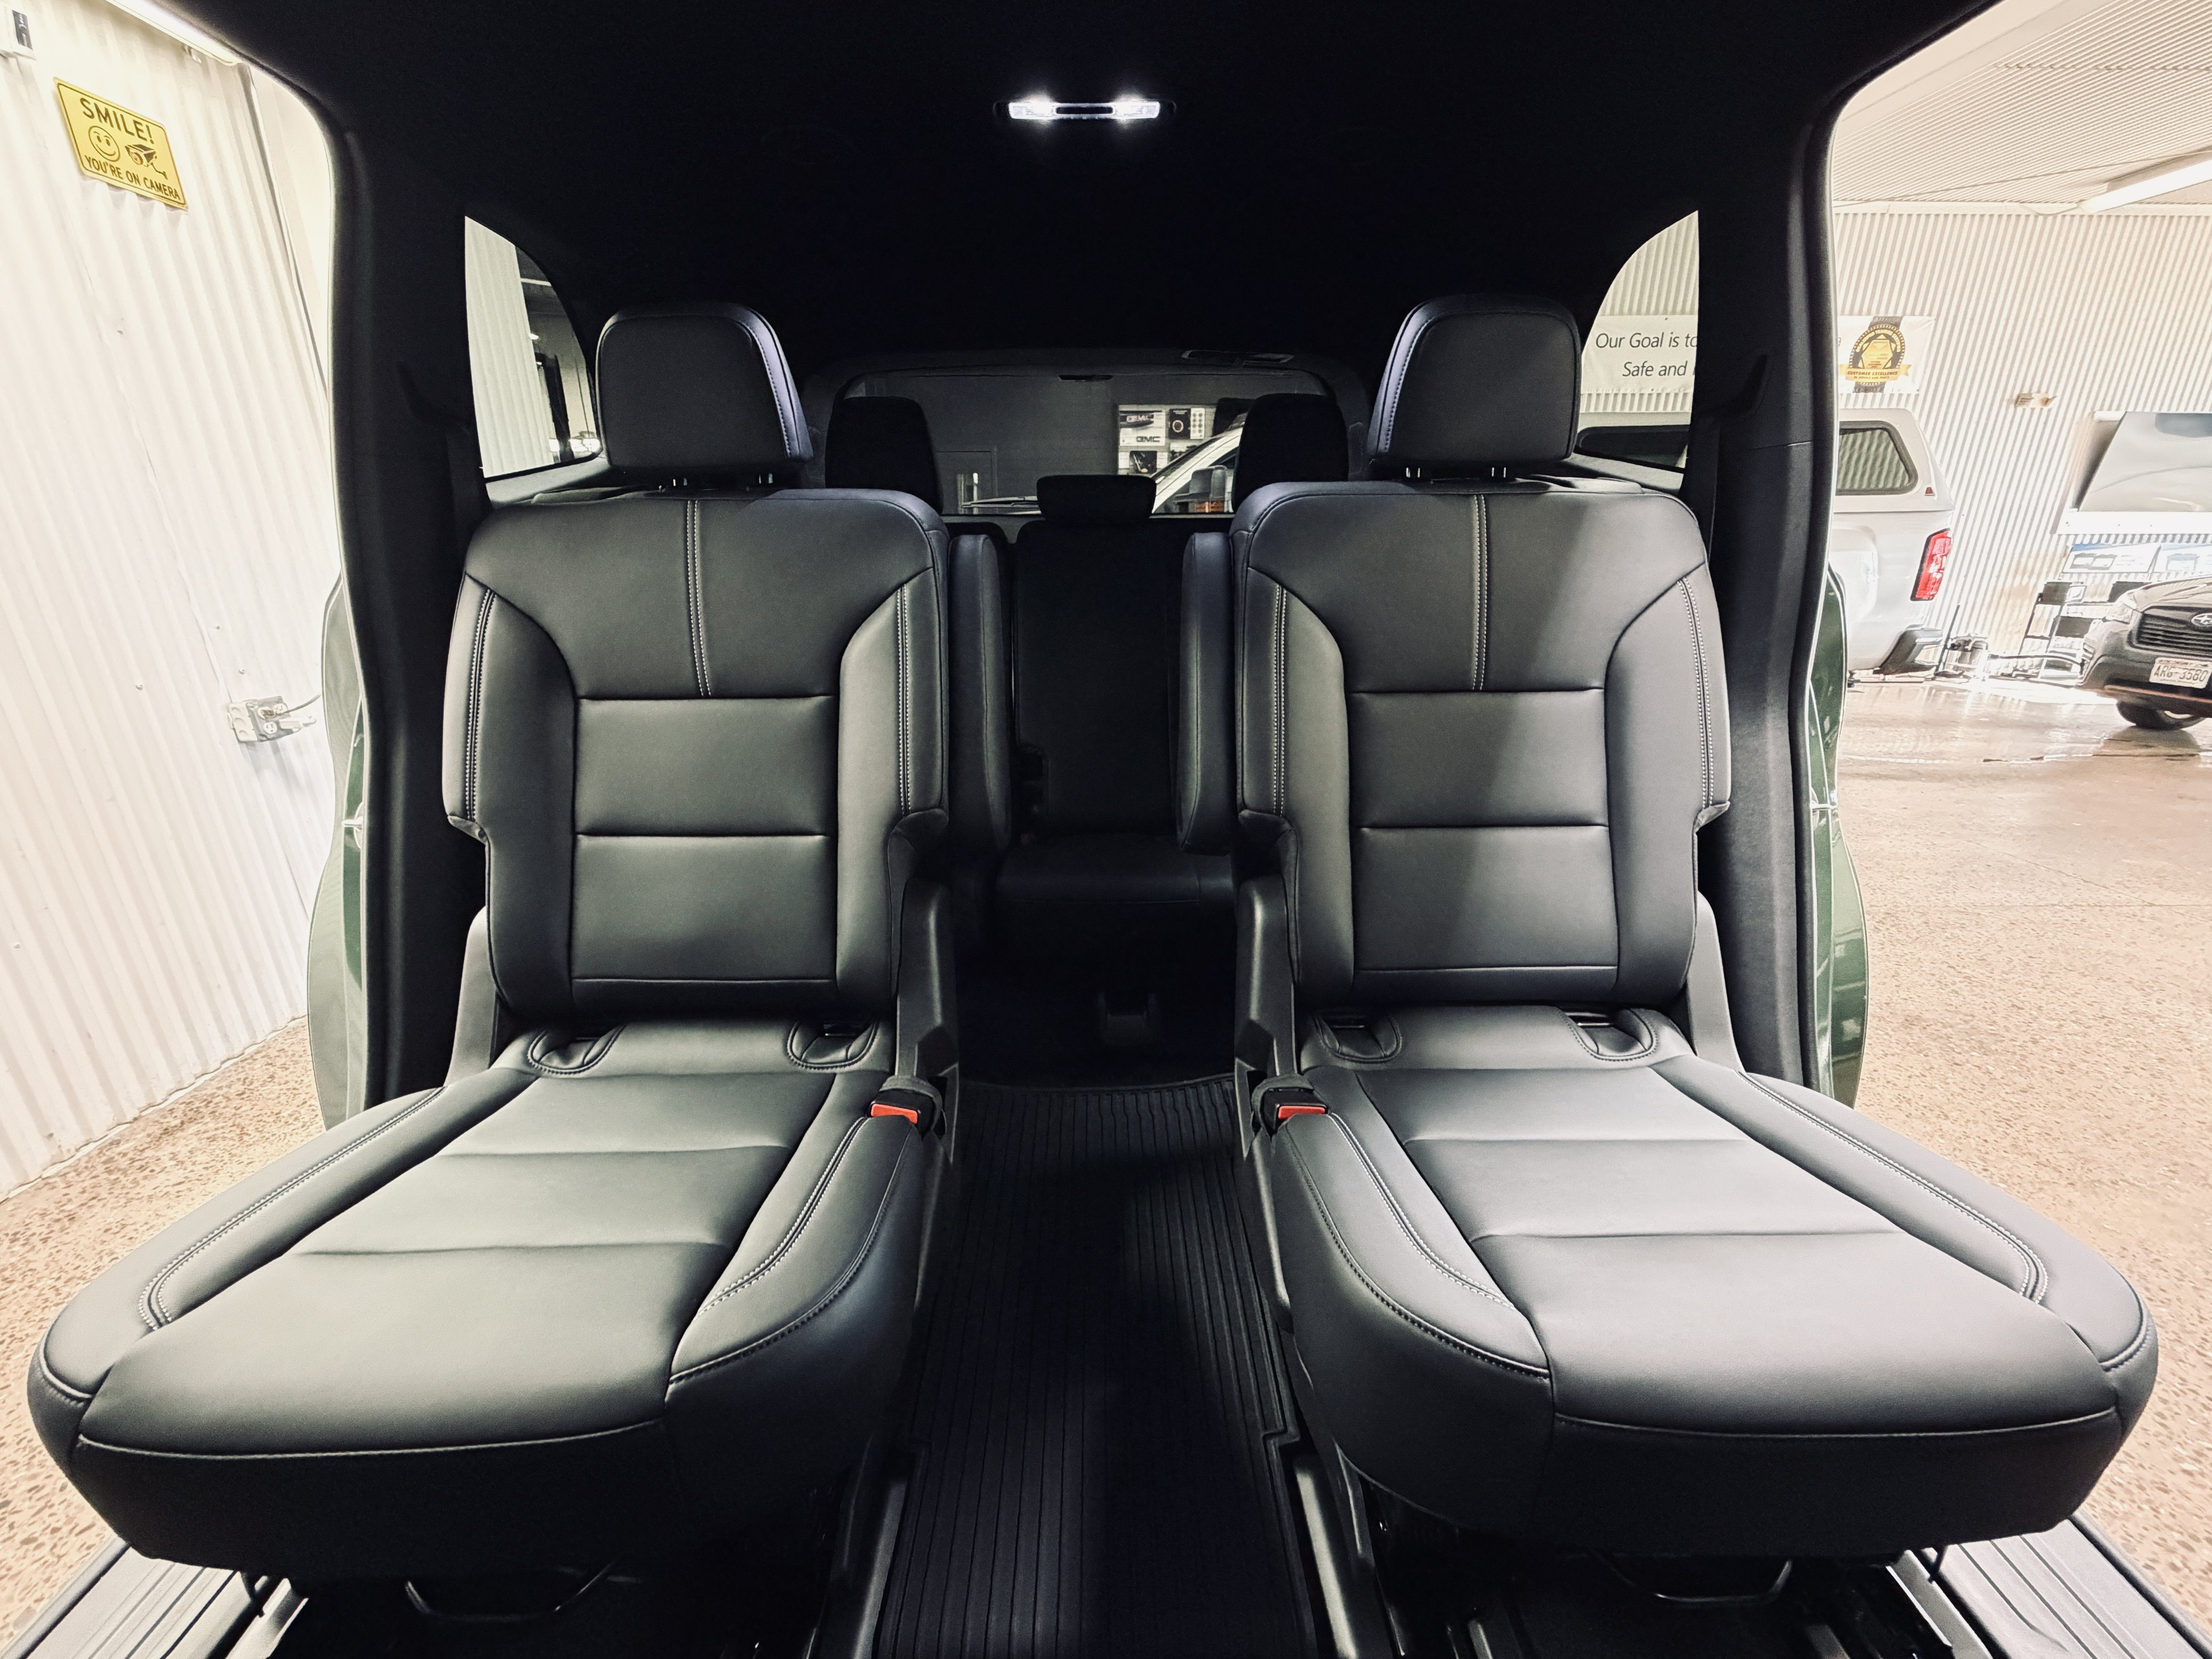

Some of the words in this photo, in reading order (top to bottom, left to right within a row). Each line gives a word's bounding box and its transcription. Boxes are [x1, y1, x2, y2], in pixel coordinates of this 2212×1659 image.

[80, 98, 155, 144] SMILE!
[84, 155, 124, 180] YOU'RE
[125, 170, 141, 186] ON
[143, 177, 181, 201] CAMERA
[1596, 333, 1625, 348] Our
[1629, 332, 1664, 348] Goal
[1668, 332, 1680, 348] is
[1622, 361, 1654, 377] Safe
[1658, 361, 1688, 376] and
